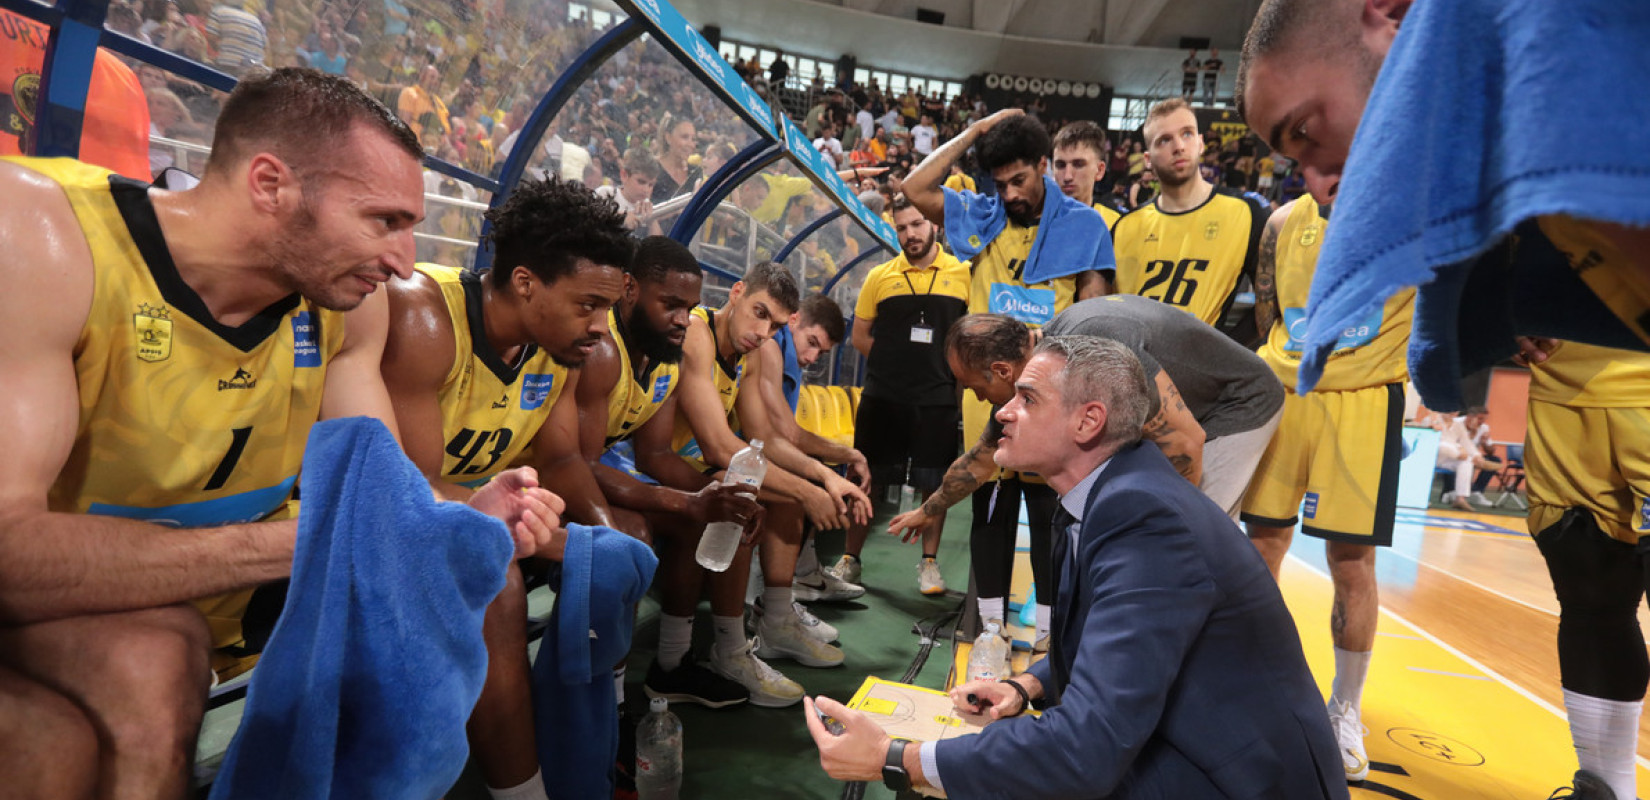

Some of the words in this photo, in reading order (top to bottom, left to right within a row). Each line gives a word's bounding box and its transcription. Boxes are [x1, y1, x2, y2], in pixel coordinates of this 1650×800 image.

[998, 293, 1048, 316] Midea
[1138, 259, 1210, 306] 26
[205, 426, 253, 491] 1
[446, 427, 513, 475] 43
